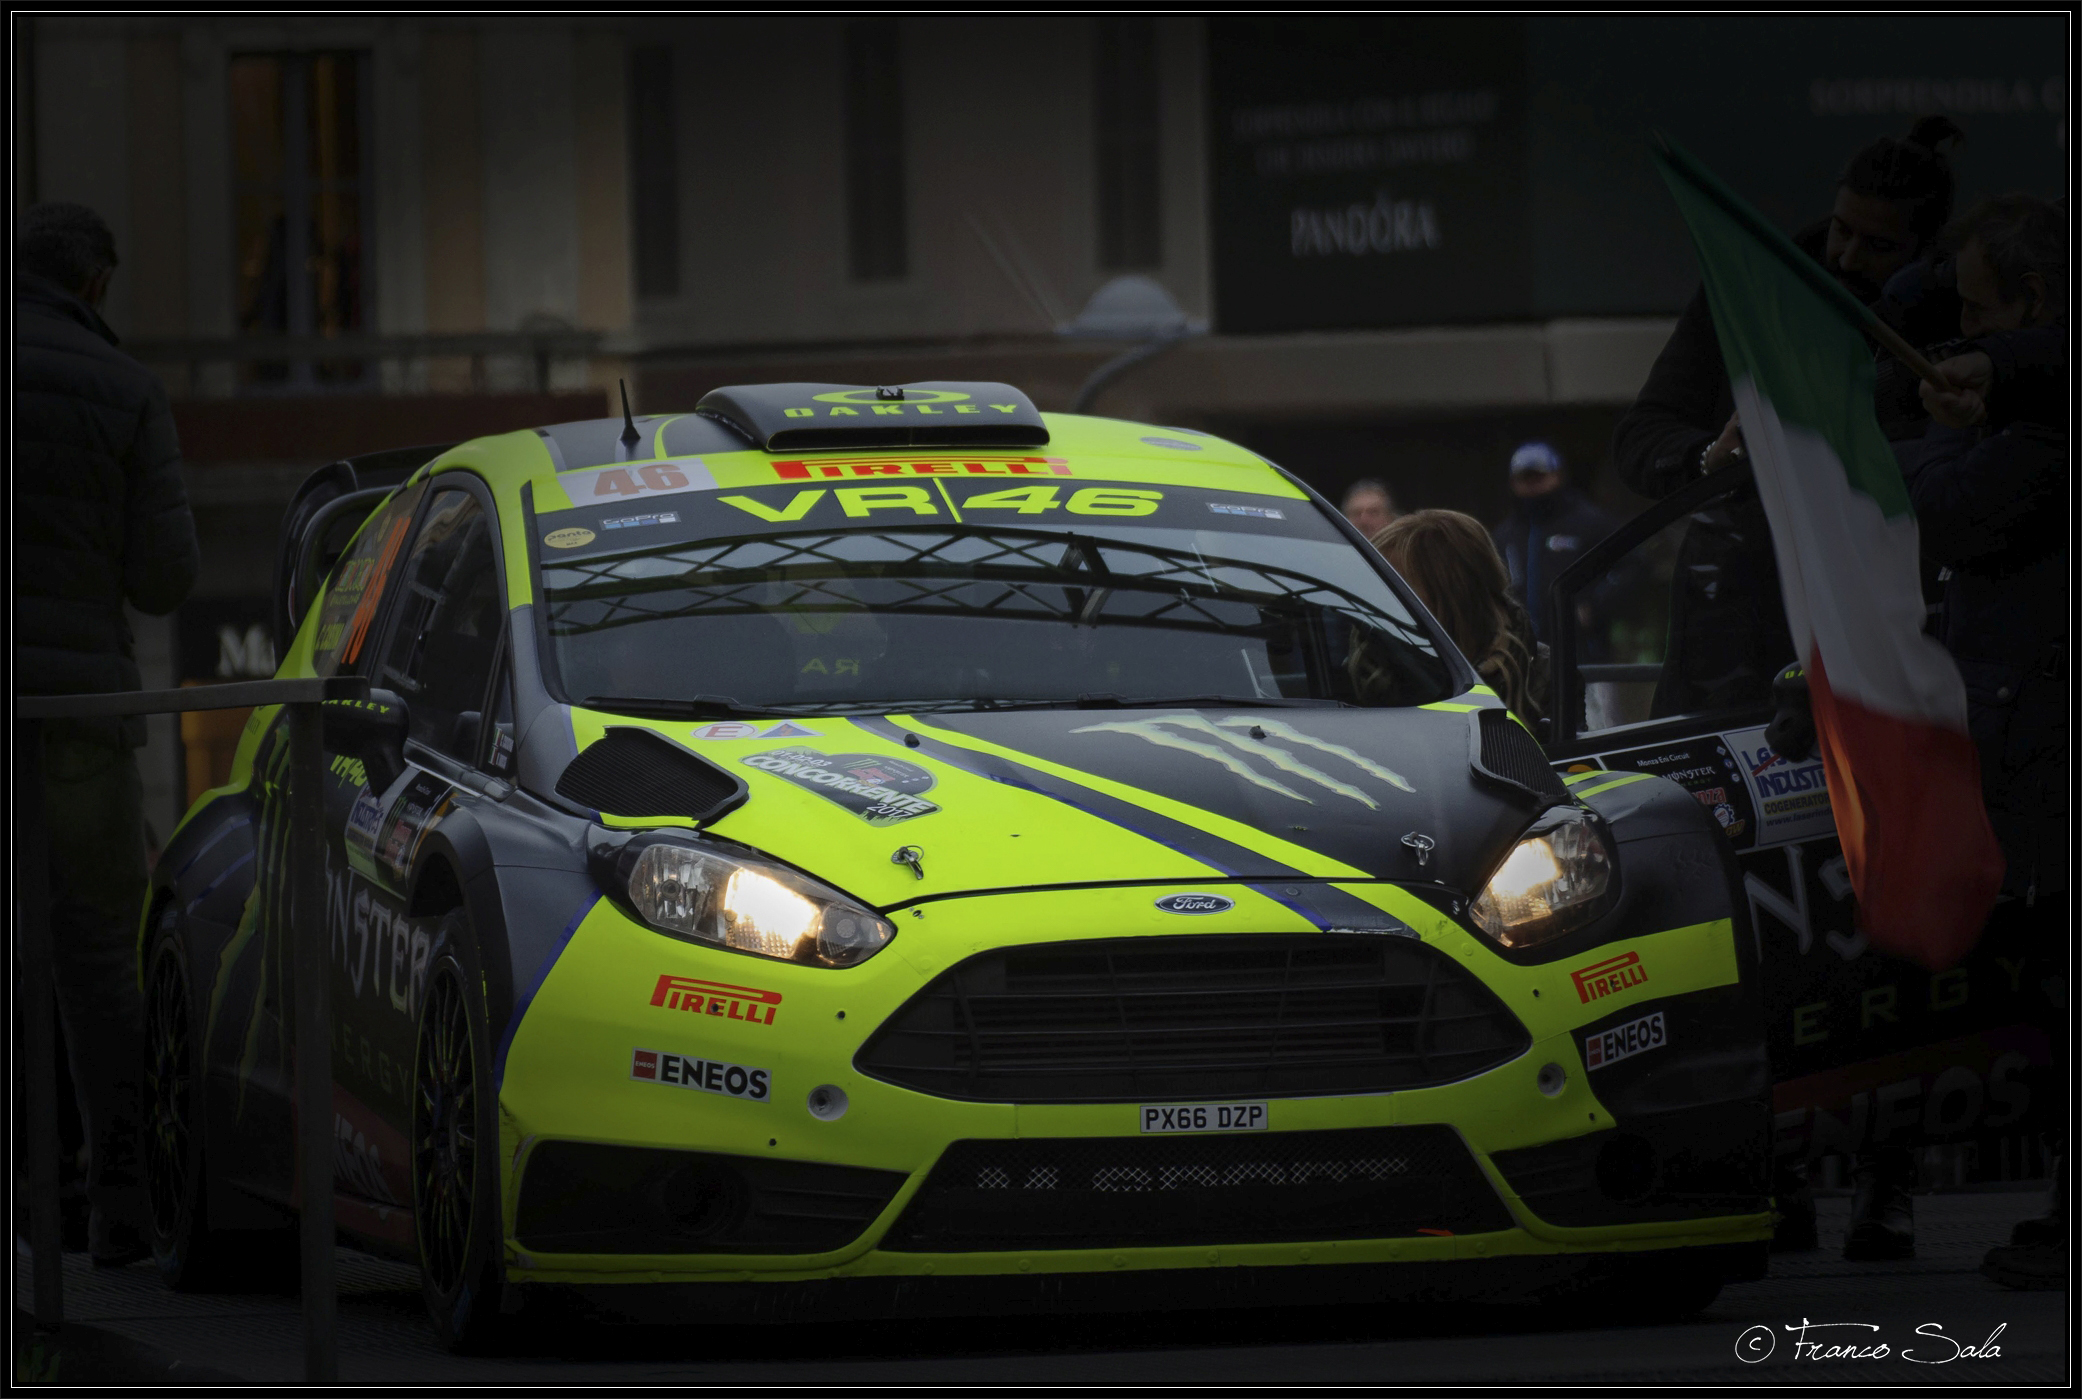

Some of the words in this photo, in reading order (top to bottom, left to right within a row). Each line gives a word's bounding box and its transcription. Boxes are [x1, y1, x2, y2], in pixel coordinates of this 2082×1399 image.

[784, 404, 1017, 418] OAKLEY
[593, 463, 690, 497] 46
[770, 456, 1072, 479] PIRELLI
[742, 755, 937, 814] CONCORRENTE
[867, 803, 913, 819] 2017
[1173, 896, 1216, 910] Ford
[1570, 951, 1648, 1004] PIRELLI
[650, 974, 782, 1025] PIRELLI
[1603, 1015, 1663, 1062] ENEOS
[661, 1054, 767, 1099] ENEOS
[1145, 1107, 1207, 1130] PX66
[1218, 1106, 1262, 1128] DZP
